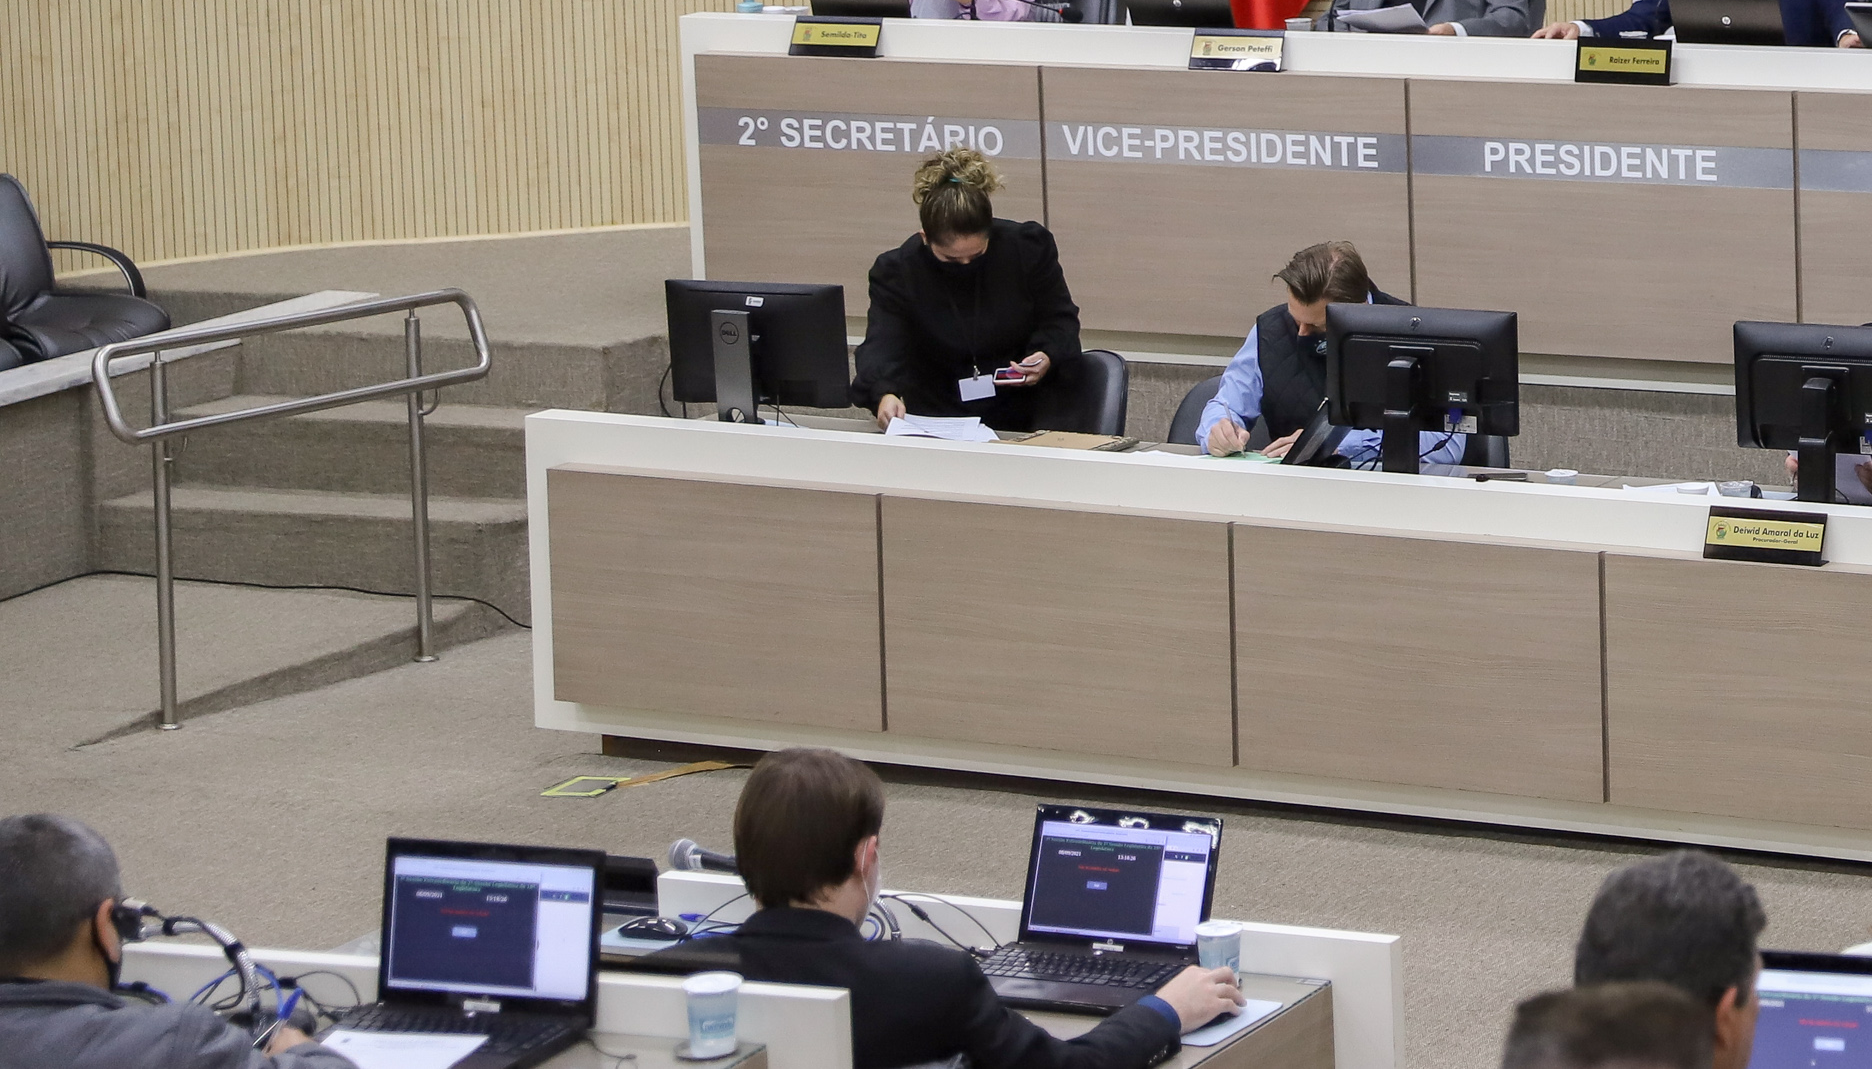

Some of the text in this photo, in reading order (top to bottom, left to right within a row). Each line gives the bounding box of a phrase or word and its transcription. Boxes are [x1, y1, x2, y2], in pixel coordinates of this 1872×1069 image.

[1217, 44, 1273, 53] Gerson Peteffi
[1609, 56, 1660, 65] Raizer Ferreira
[780, 117, 1003, 156] SECRETÁRIO
[1062, 124, 1379, 168] VICE-PRESIDENTE
[1483, 141, 1718, 181] PRESIDENTE
[1733, 525, 1819, 539] Deiwid Amaral da Luz
